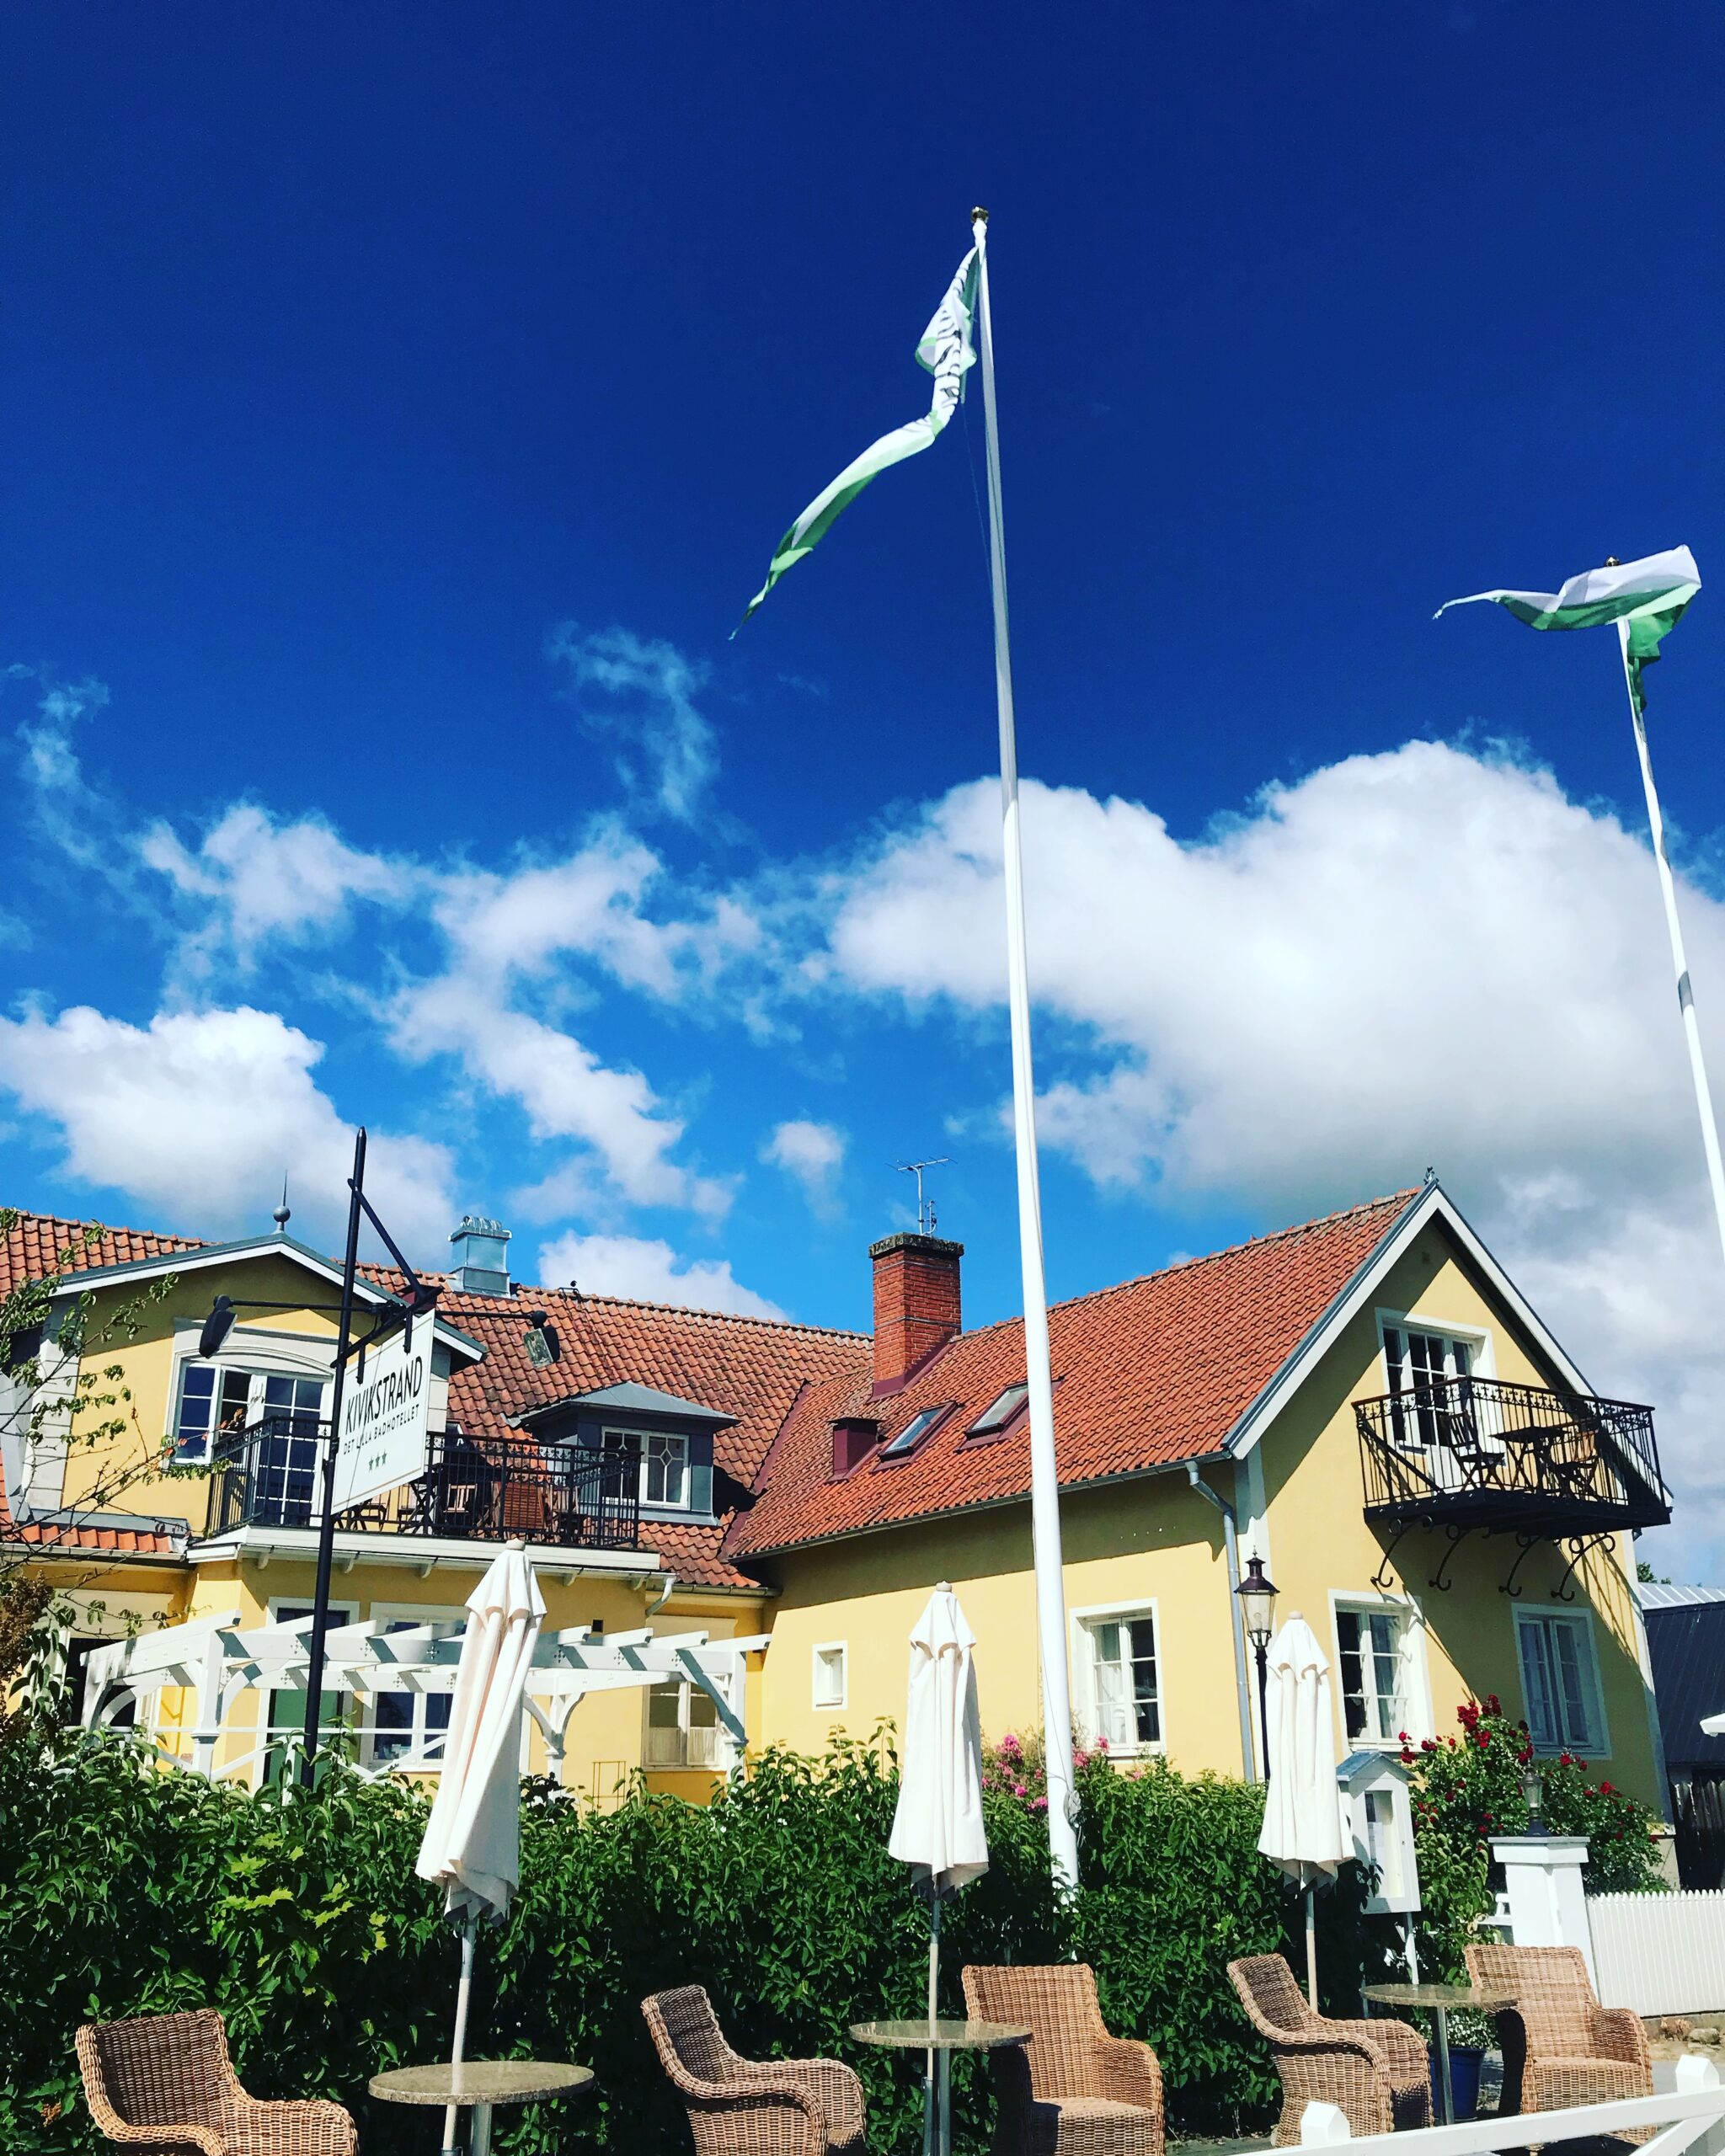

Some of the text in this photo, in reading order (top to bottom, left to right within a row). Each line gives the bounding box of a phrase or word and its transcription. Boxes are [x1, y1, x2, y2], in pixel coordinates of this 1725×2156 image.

[345, 1355, 423, 1435] KIVIKSTRAND
[344, 1438, 355, 1455] DET
[374, 1404, 419, 1439] BADHOTELLET
